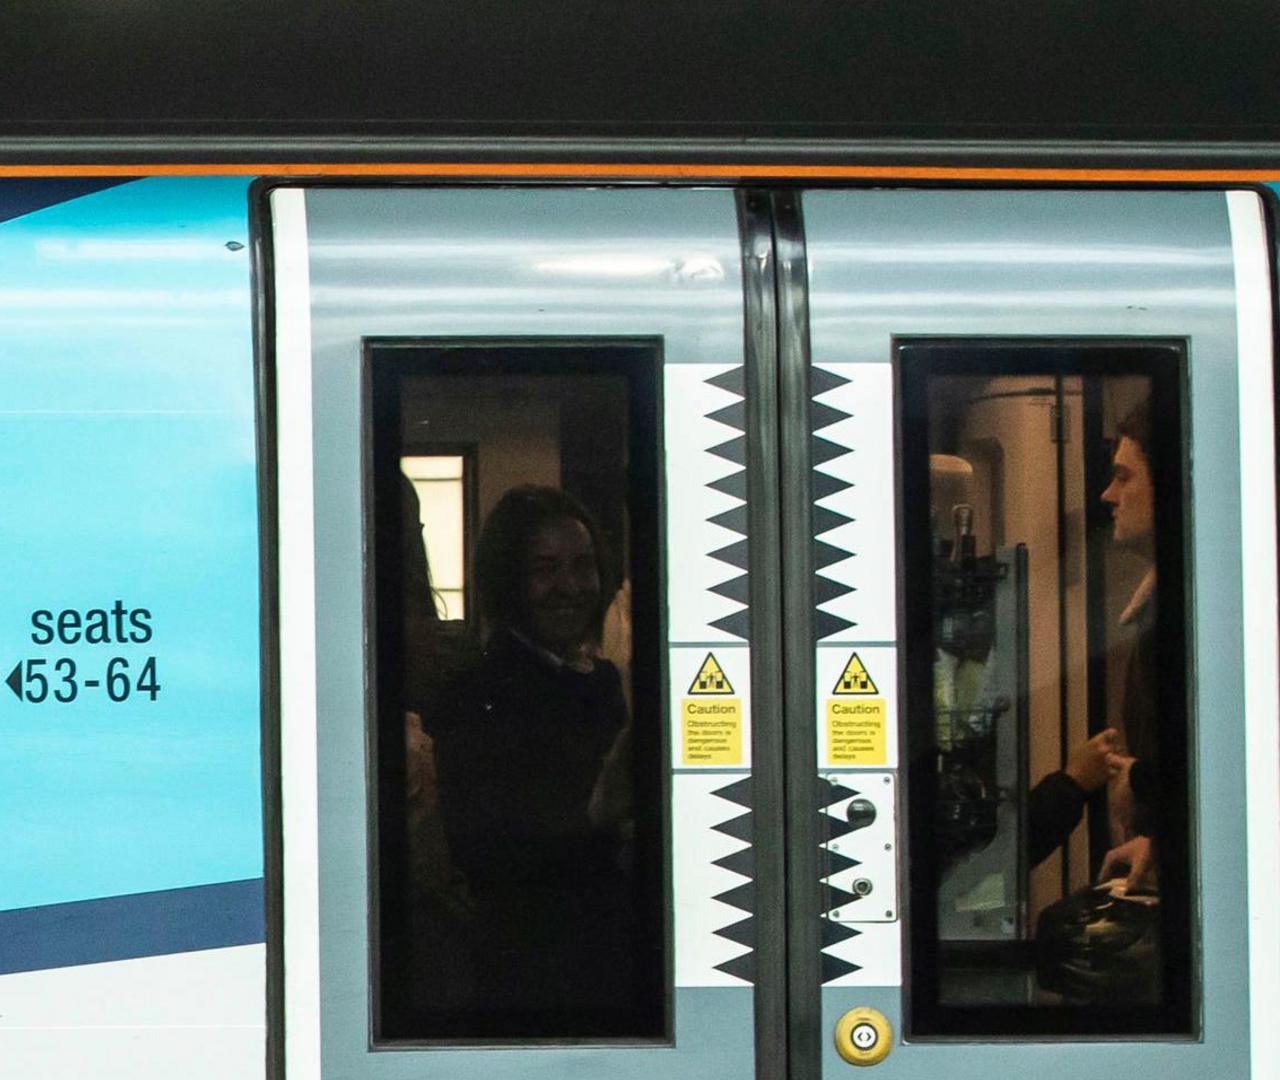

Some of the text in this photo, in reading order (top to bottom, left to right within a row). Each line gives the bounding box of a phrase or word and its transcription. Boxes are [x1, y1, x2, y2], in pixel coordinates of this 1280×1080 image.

[30, 600, 153, 645] seats
[24, 656, 162, 703] 53-64
[687, 703, 736, 714] Caution
[832, 703, 881, 714] Caution
